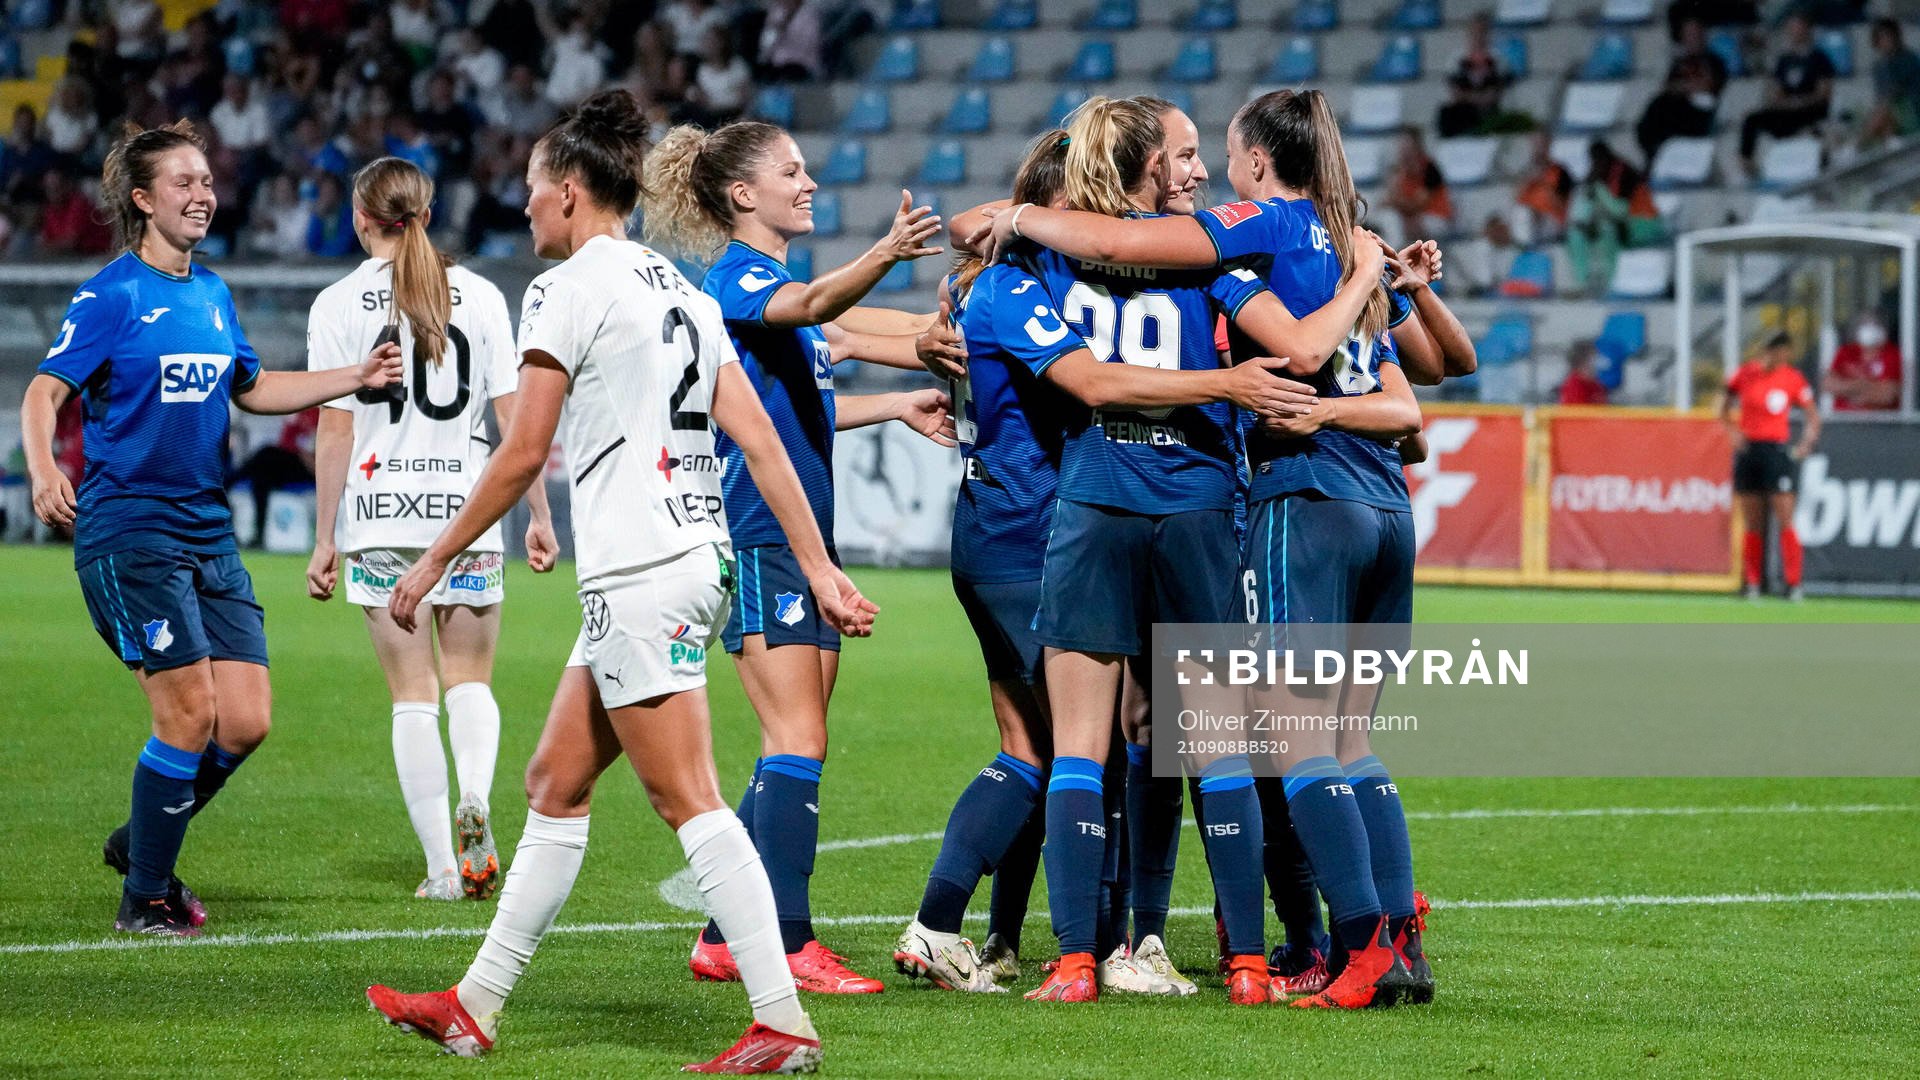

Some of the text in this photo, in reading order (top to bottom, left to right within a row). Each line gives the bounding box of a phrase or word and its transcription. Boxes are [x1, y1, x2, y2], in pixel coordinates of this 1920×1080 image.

[163, 362, 218, 393] SAP
[355, 323, 471, 425] 40
[662, 306, 708, 431] 2
[1242, 569, 1260, 625] 6
[1325, 784, 1355, 797] TS
[1375, 783, 1398, 796] TS
[1077, 821, 1106, 839] TSG
[1206, 823, 1240, 837] TSG
